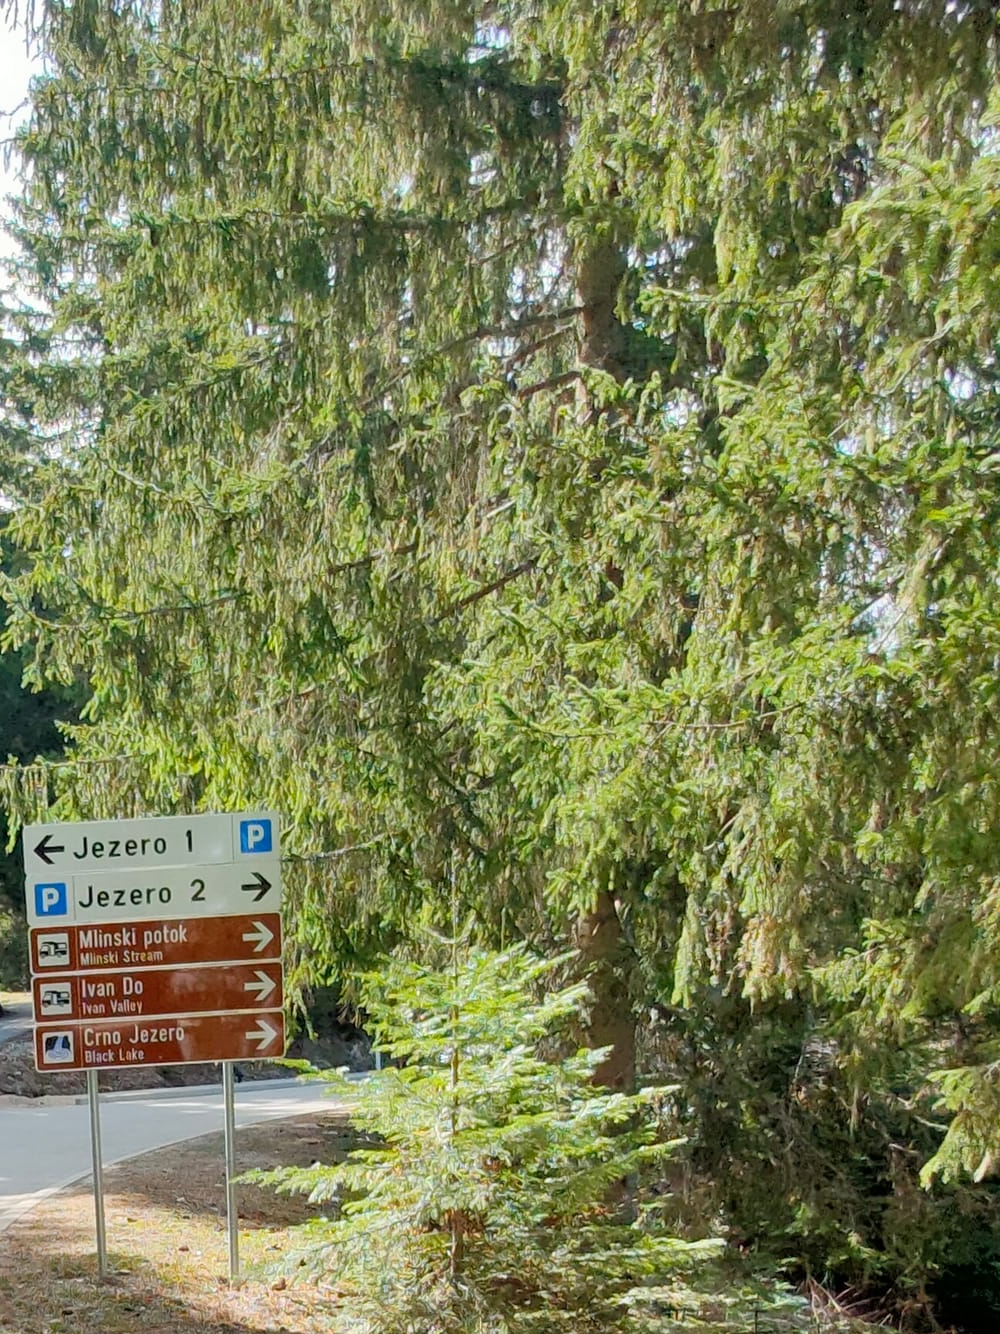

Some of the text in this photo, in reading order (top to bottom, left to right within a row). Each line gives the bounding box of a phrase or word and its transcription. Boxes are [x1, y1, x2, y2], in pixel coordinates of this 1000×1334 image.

[73, 824, 265, 859] Jezero 1 P
[42, 879, 206, 912] P Jezero 2
[79, 925, 188, 949] Mlinski potok
[80, 949, 163, 966] Mlinski Stream
[81, 976, 144, 998] Ivan Do
[82, 999, 143, 1015] Ivan Valley
[84, 1024, 185, 1047] Crno Jezero
[85, 1048, 145, 1064] Black Lake
